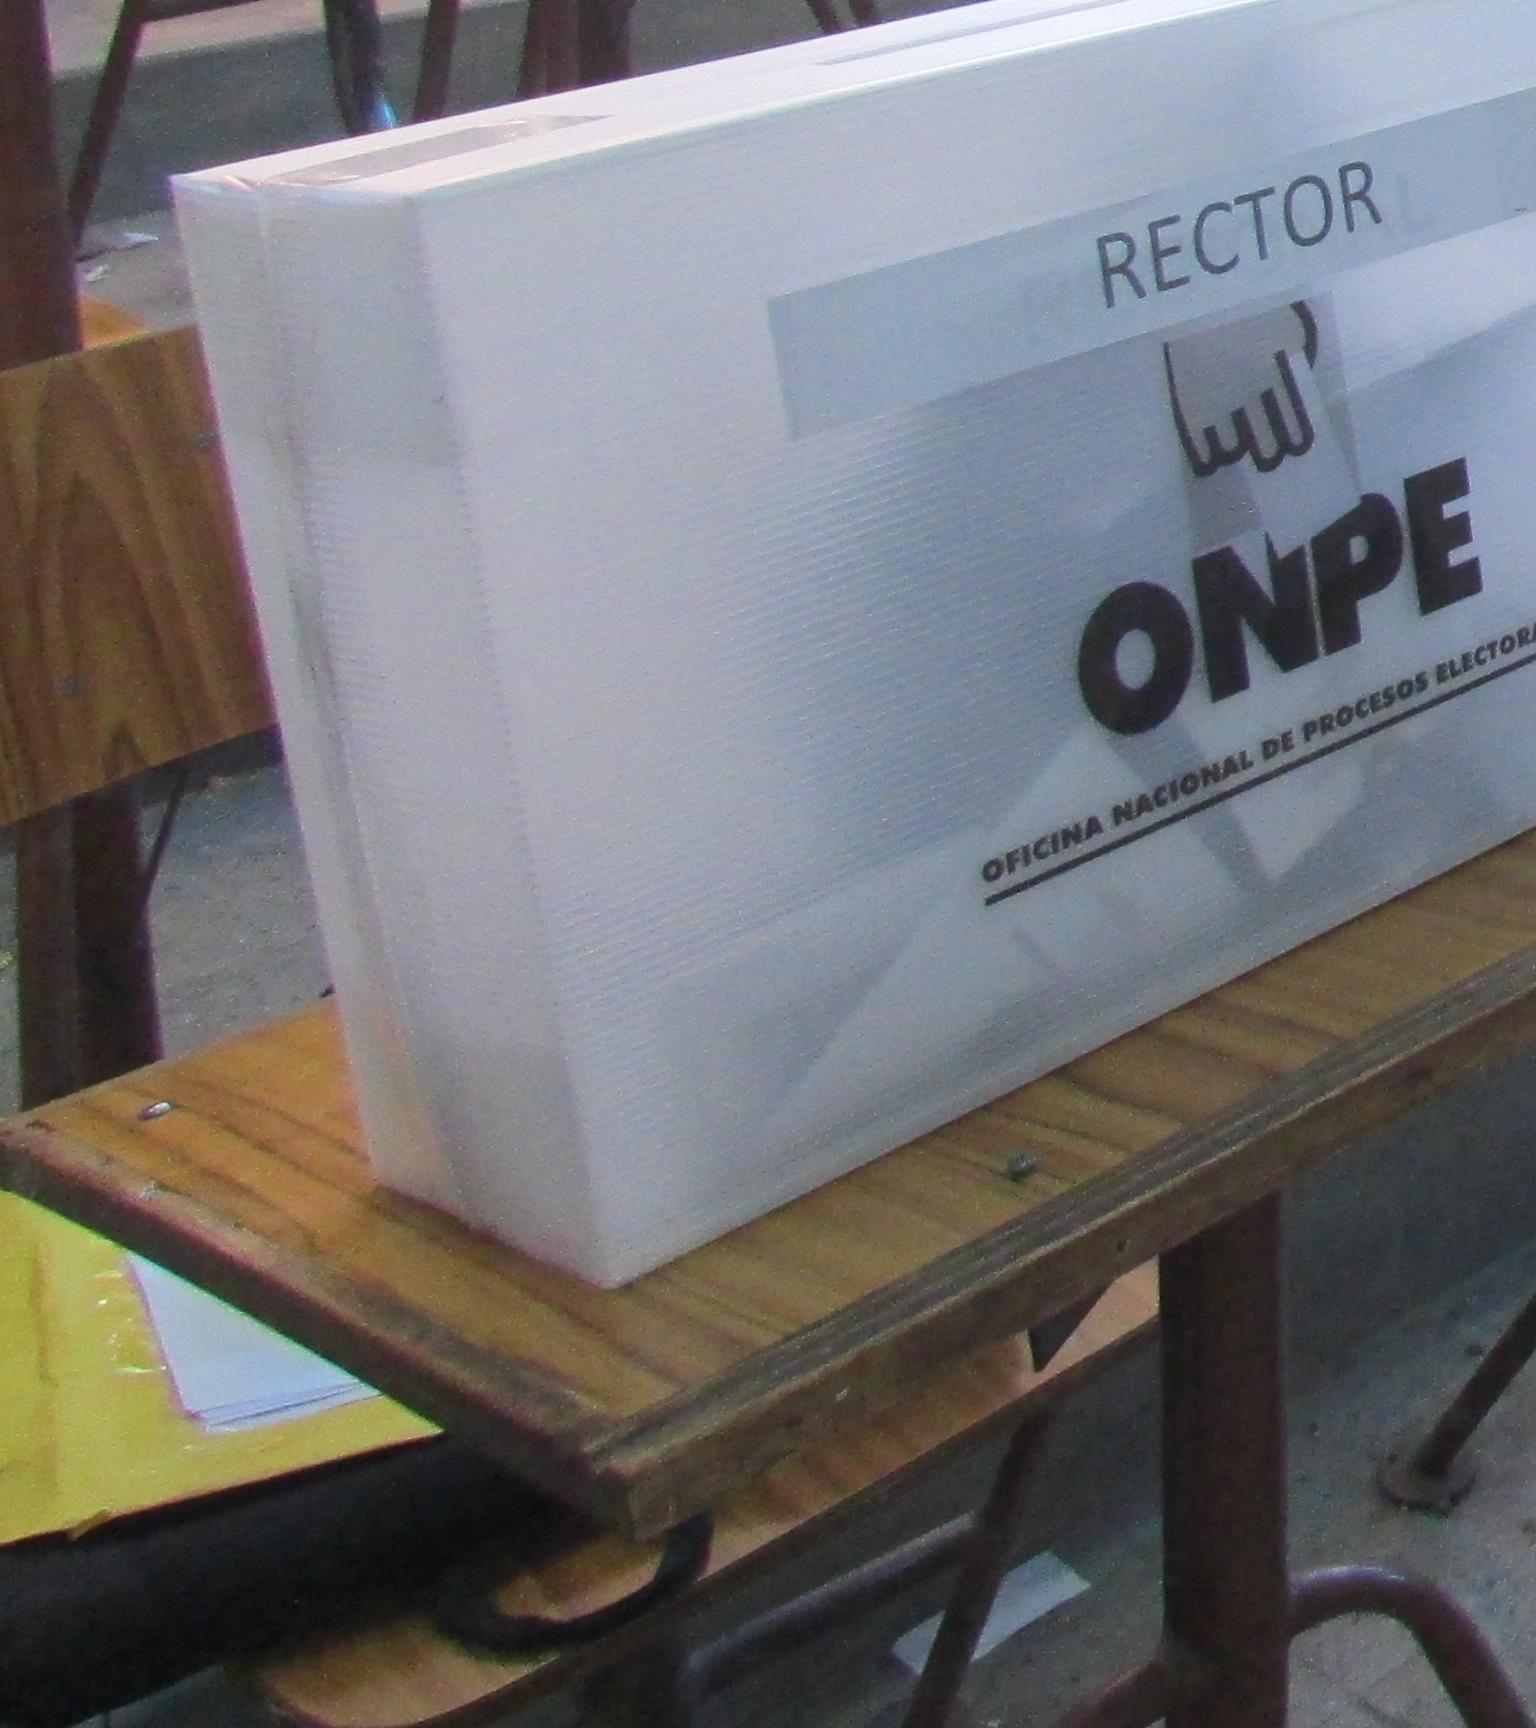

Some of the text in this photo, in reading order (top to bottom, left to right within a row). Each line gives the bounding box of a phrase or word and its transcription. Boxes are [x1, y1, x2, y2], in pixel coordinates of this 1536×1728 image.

[1097, 160, 1384, 310] RECTOR
[1078, 456, 1483, 736] ONPE
[982, 814, 1104, 883] OFICINA
[1111, 750, 1254, 827] NACIONAL
[1261, 730, 1295, 762] DE
[1302, 671, 1429, 743] PROCESOS
